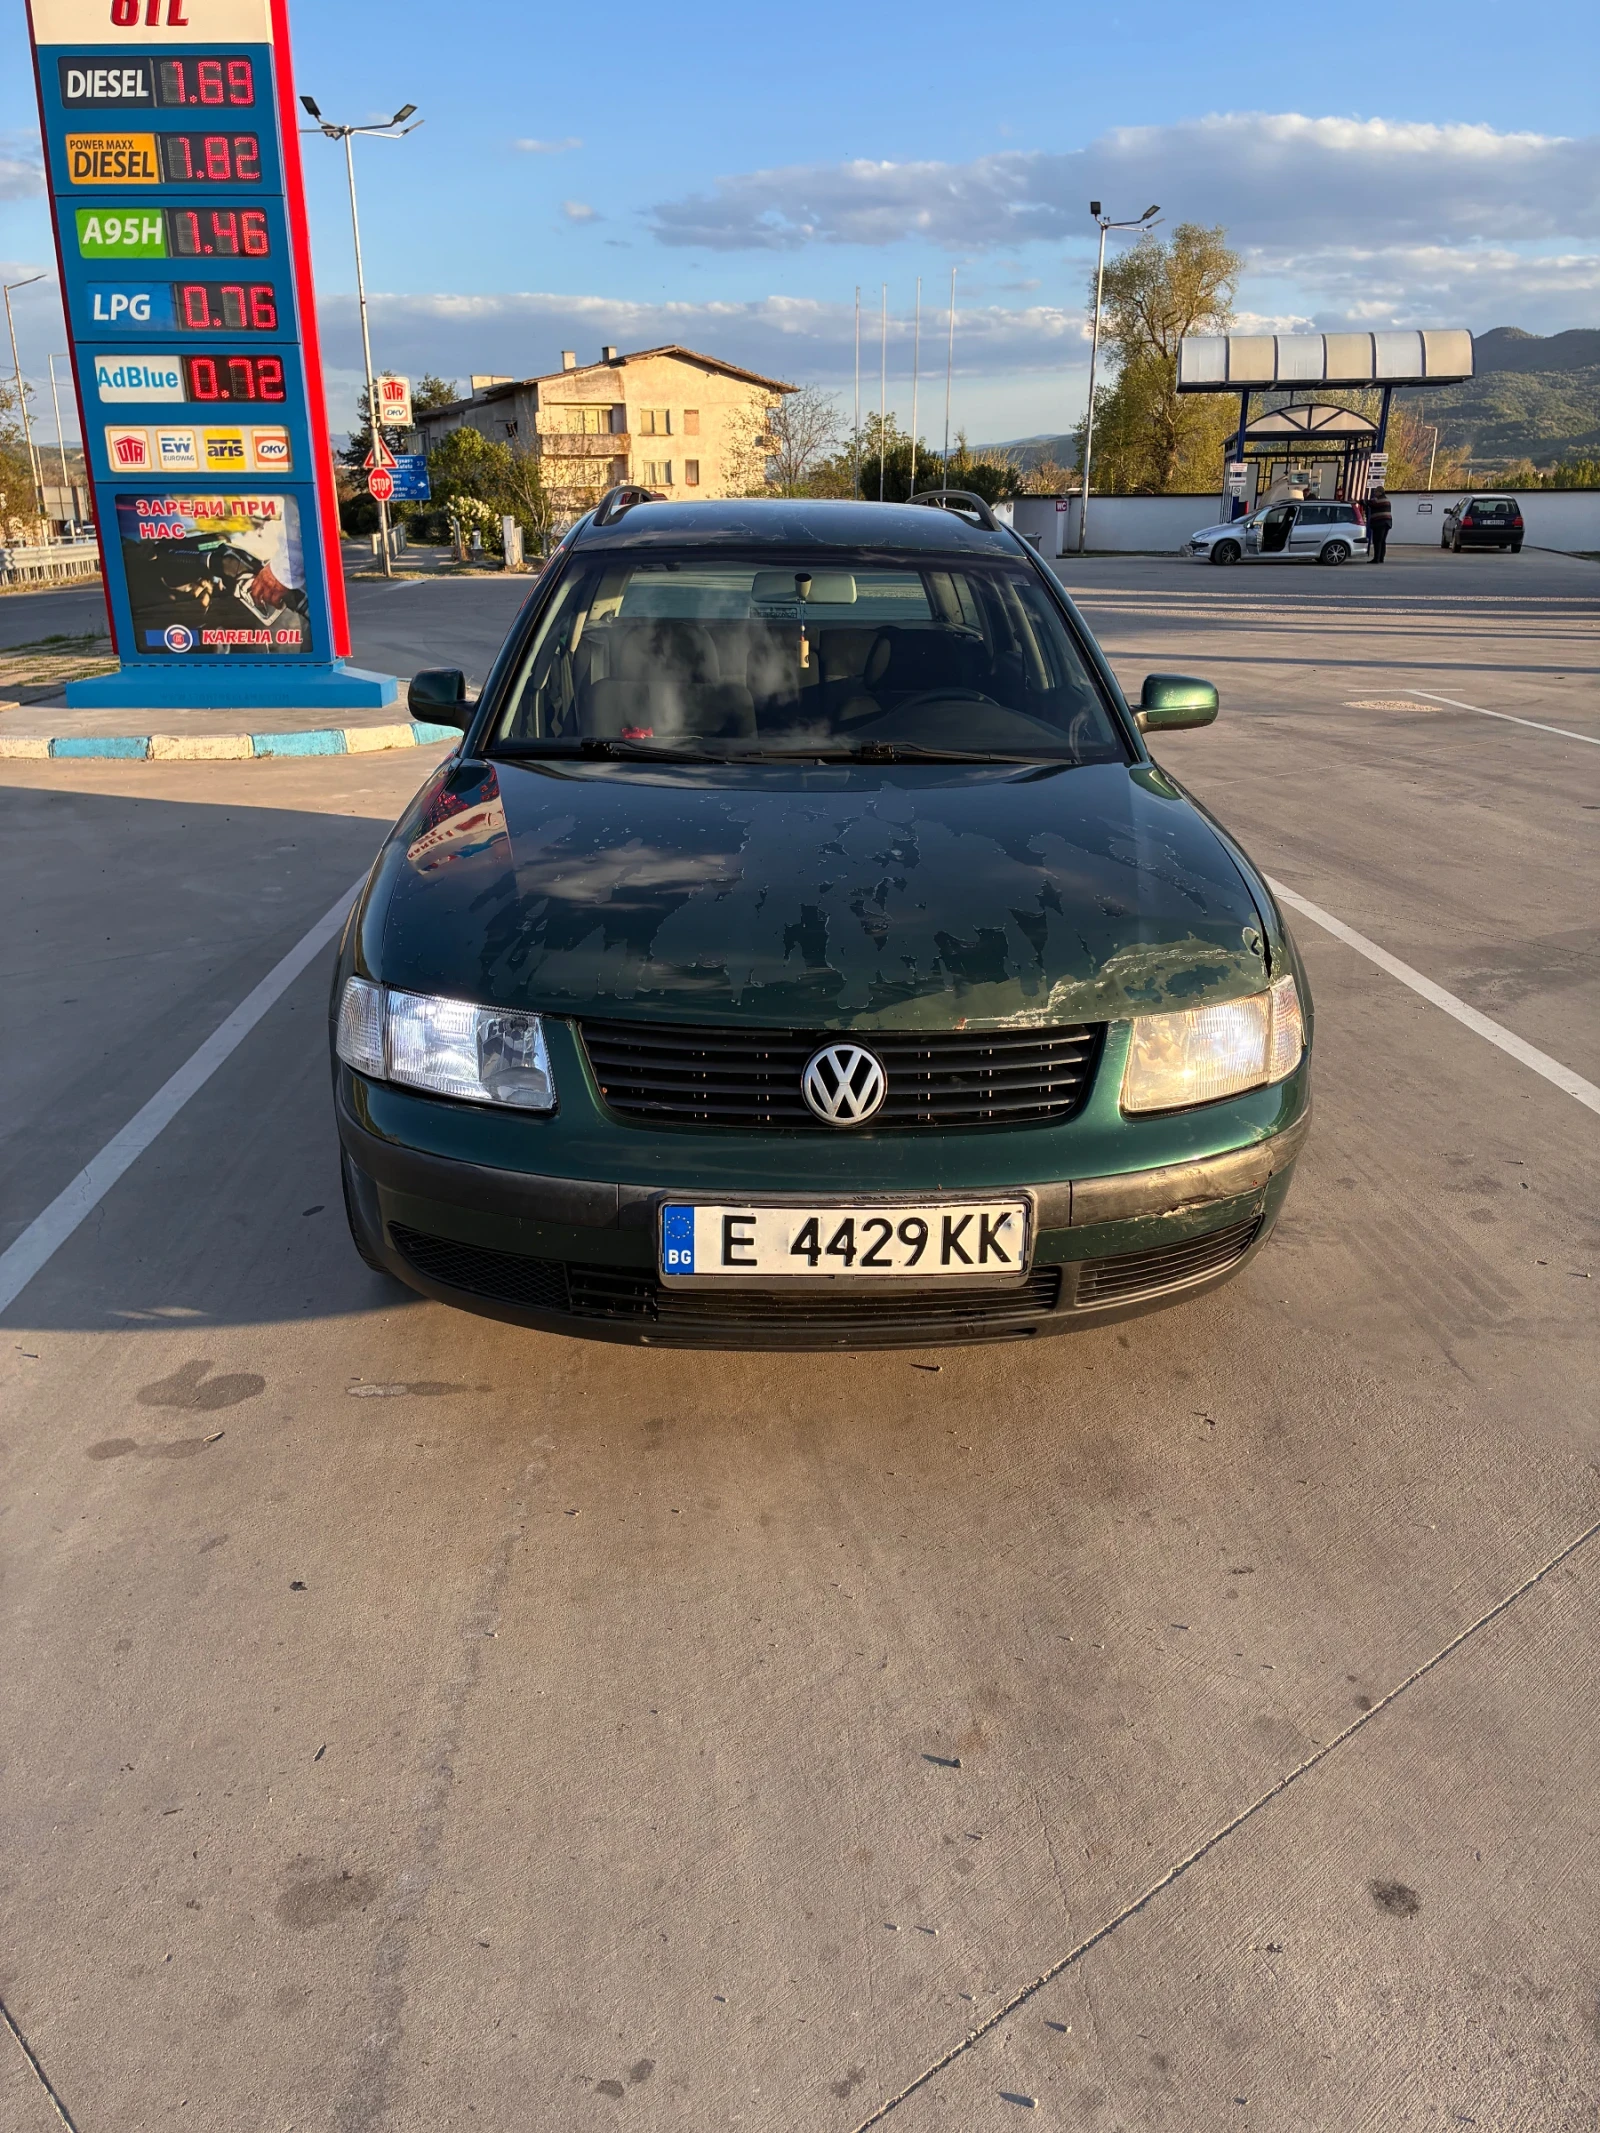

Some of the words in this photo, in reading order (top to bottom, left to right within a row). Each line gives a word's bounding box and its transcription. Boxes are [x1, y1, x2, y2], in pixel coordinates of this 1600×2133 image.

[67, 69, 149, 98] DIESEL
[172, 61, 254, 104] 1.69
[70, 140, 104, 150] POWER
[106, 140, 134, 149] MAXX
[74, 151, 155, 178] DIESEL
[177, 137, 260, 179] 1.82
[82, 217, 163, 245] A95H
[186, 212, 269, 255] 1.46
[94, 294, 151, 321] LPG
[183, 286, 277, 328] 0.76
[98, 366, 179, 388] AdBlue
[191, 359, 284, 399] 0.72
[382, 381, 406, 401] UTA
[114, 436, 146, 464] UTA
[207, 444, 244, 457] aris
[260, 445, 286, 454] DKV
[371, 478, 390, 492] STOP
[136, 500, 224, 518] ЗАРЕДИ
[231, 501, 276, 516] ПРИ
[1056, 502, 1067, 510] WC
[139, 523, 186, 539] НАС
[202, 629, 272, 645] KARELIA
[276, 629, 303, 644] OIL
[668, 1249, 692, 1265] BG
[721, 1214, 758, 1267] E
[789, 1216, 929, 1267] 4429
[941, 1212, 1012, 1265] KK
